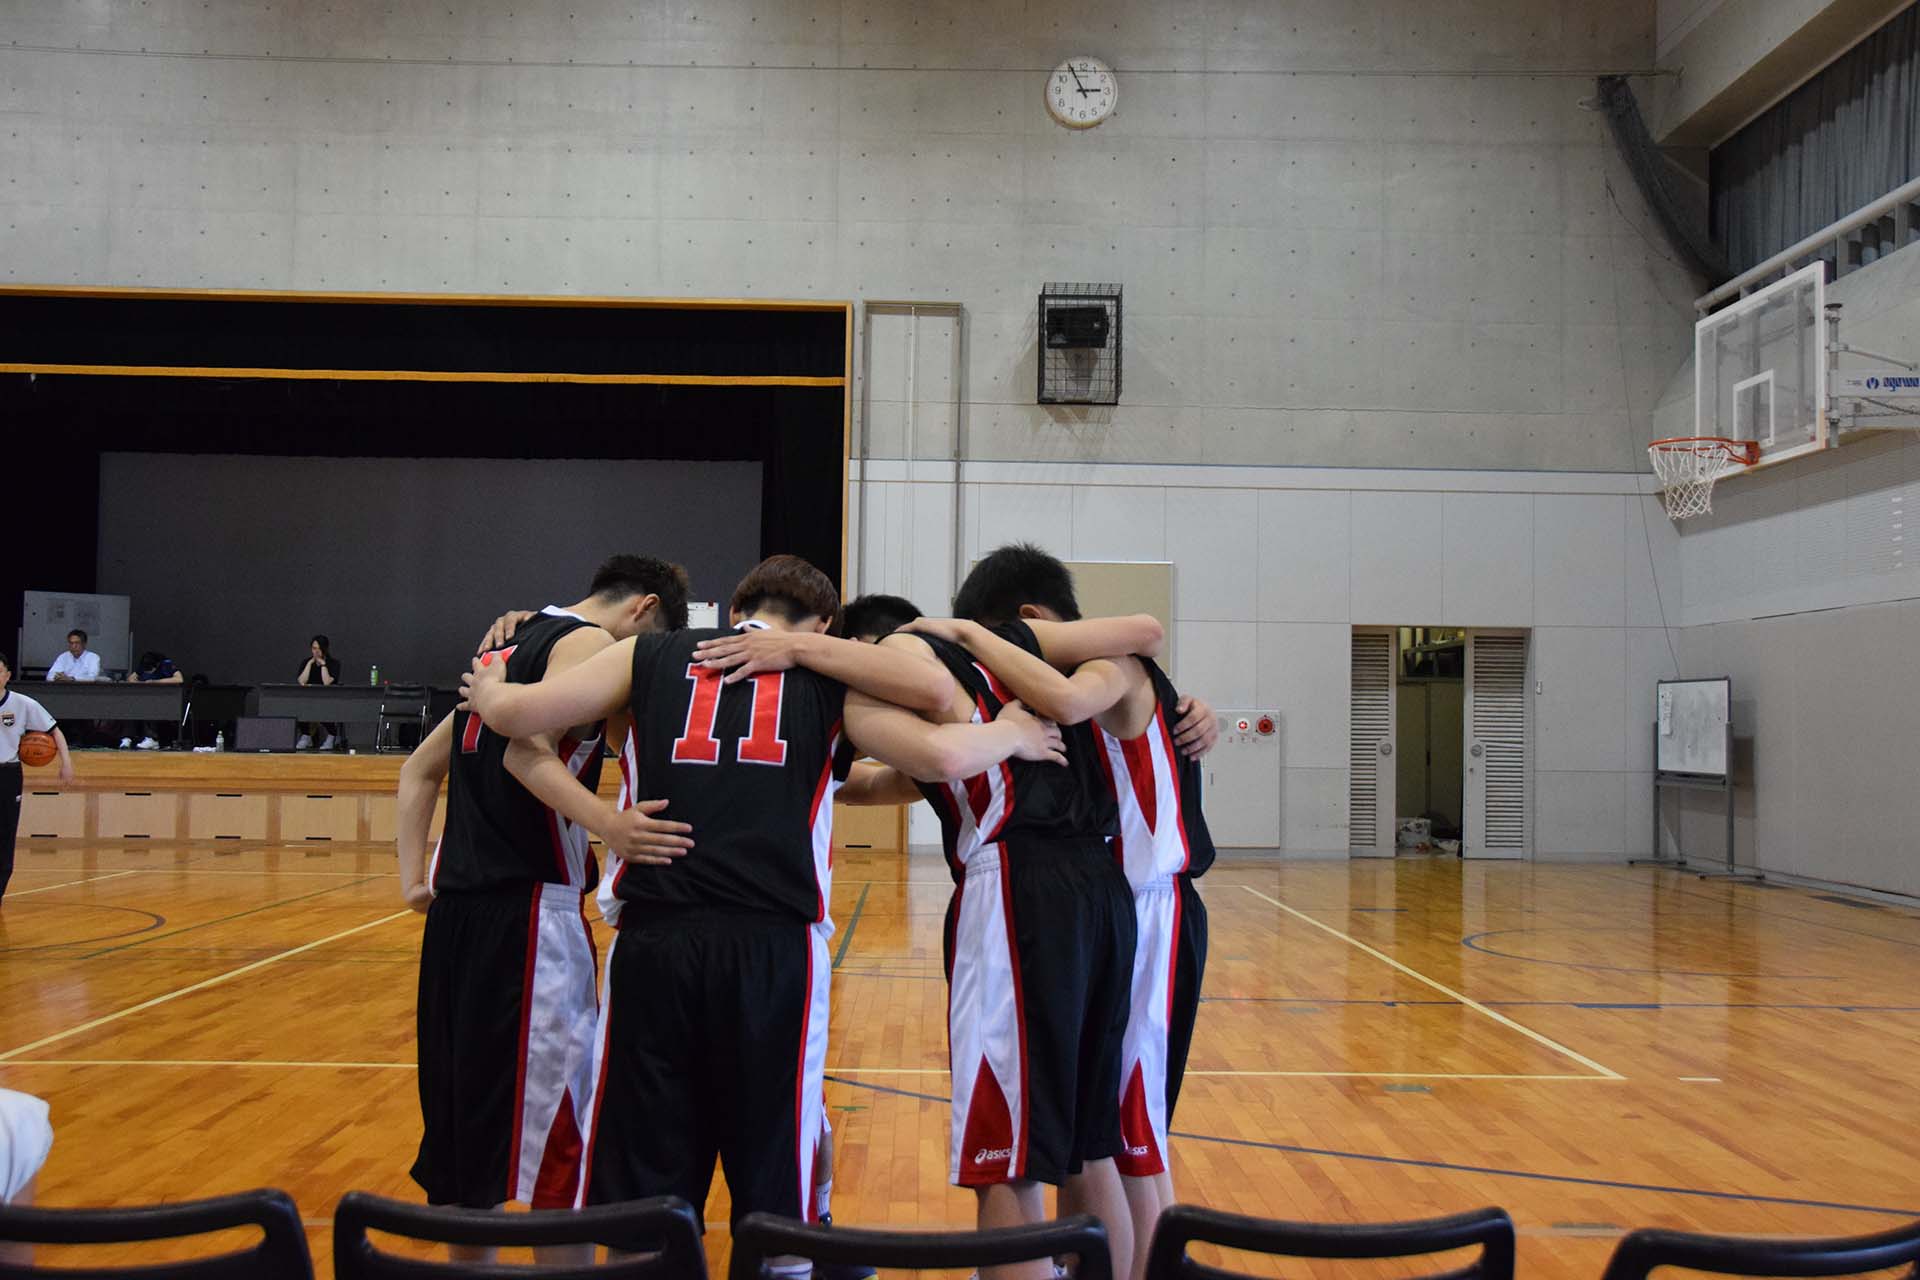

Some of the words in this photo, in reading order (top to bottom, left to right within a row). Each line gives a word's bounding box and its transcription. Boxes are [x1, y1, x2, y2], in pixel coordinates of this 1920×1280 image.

[1079, 63, 1088, 72] 12
[1058, 75, 1068, 84] 10
[1104, 87, 1111, 95] 3
[1058, 98, 1065, 107] 8
[1079, 111, 1086, 119] 6
[671, 663, 788, 766] 11
